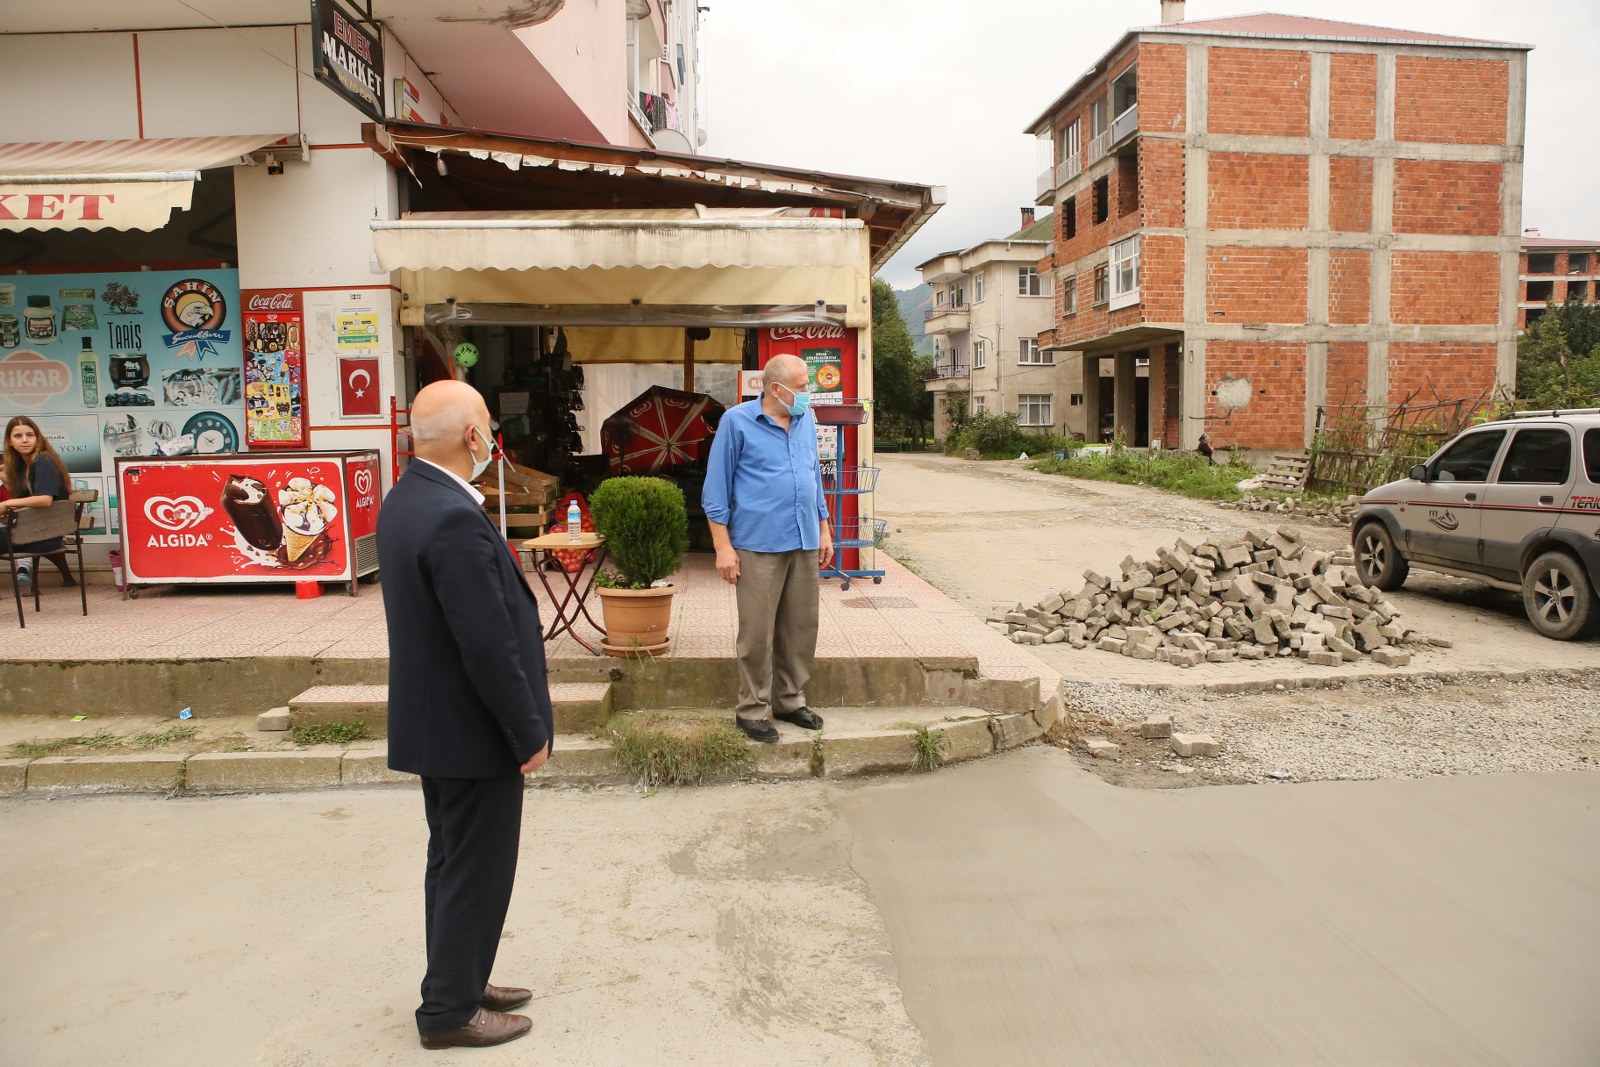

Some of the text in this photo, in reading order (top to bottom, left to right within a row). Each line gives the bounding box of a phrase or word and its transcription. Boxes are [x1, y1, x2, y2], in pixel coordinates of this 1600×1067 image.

[333, 10, 372, 65] EMEK
[323, 31, 382, 96] MARKET
[249, 293, 295, 311] Coca-Cola
[59, 445, 87, 453] YOK!
